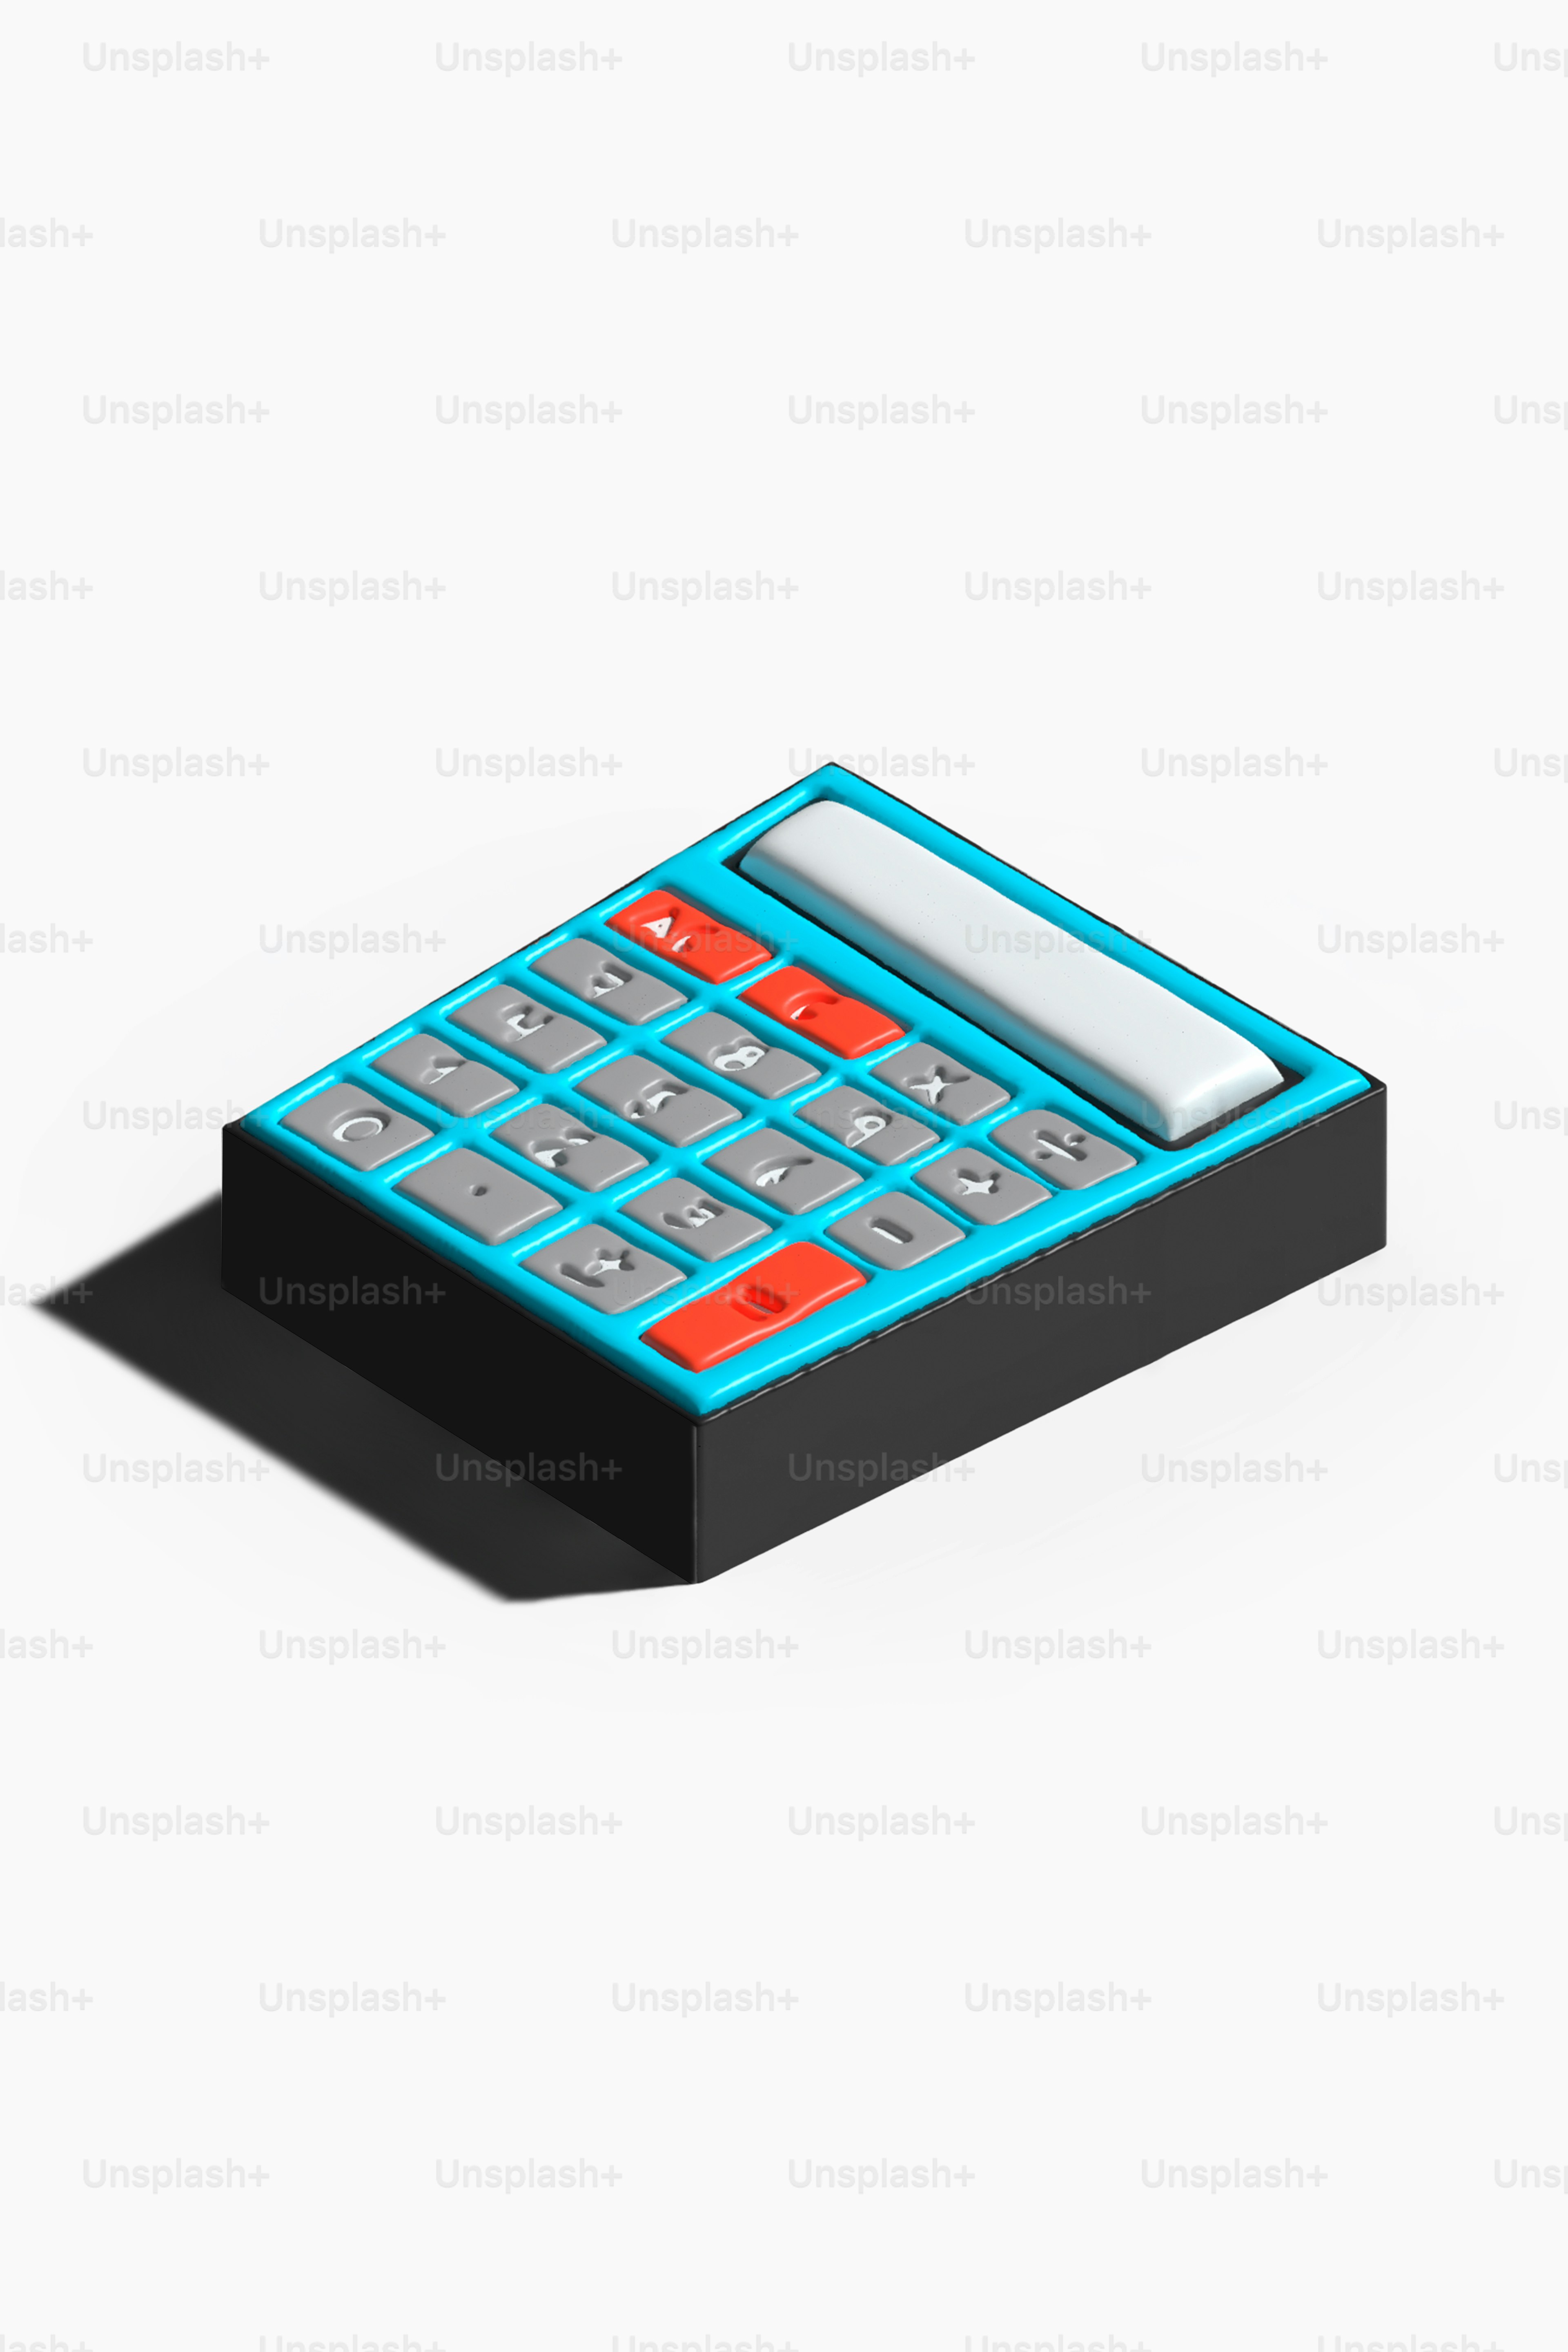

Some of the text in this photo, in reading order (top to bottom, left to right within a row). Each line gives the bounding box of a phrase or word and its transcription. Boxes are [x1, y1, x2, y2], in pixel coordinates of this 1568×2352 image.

[637, 907, 719, 953] AC
[708, 1037, 770, 1071] 8
[846, 1106, 892, 1147] 9
